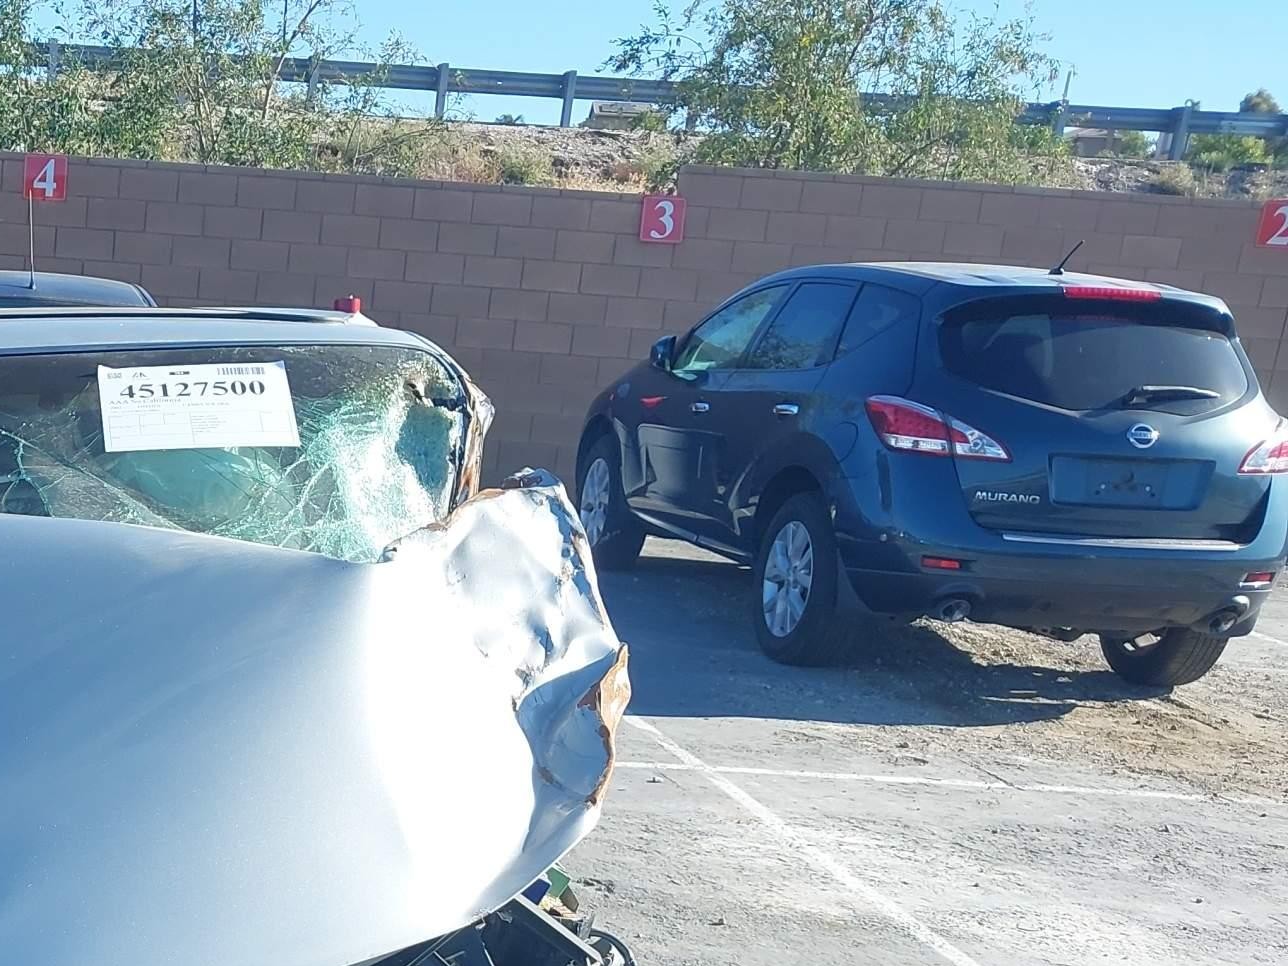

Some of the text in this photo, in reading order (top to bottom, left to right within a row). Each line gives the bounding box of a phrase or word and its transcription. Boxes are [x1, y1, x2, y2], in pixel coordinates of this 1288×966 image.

[32, 158, 57, 197] 4
[649, 200, 674, 239] 3
[1265, 205, 1288, 246] 2
[119, 379, 265, 399] 45127500
[975, 490, 1041, 504] MURANO
